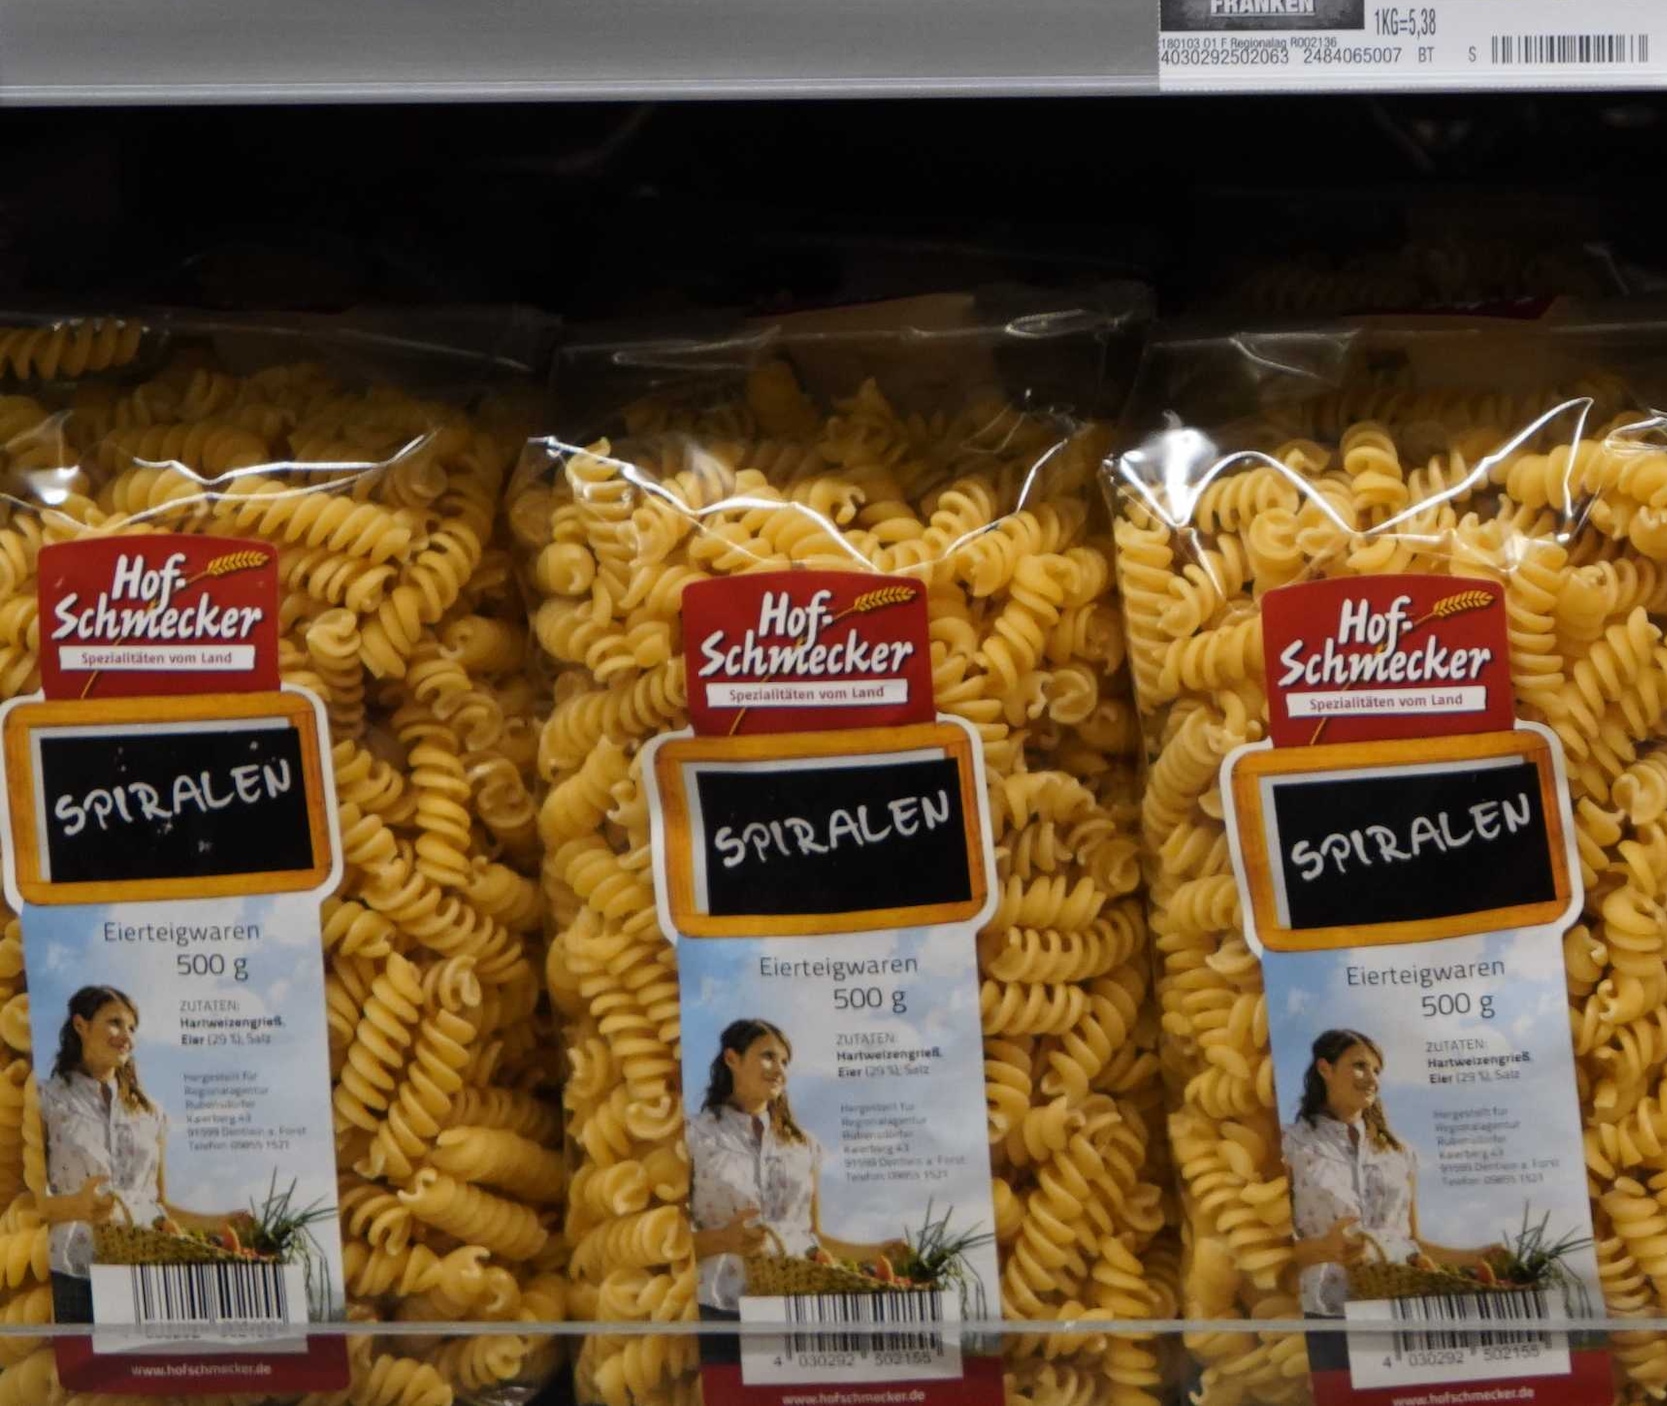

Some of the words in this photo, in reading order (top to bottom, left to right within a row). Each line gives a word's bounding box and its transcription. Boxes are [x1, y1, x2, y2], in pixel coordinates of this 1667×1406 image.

[1220, 38, 1227, 48] F
[1374, 8, 1437, 39] 1KG=5,38
[1161, 48, 1290, 66] 4030292502063
[1303, 48, 1402, 64] 2484065007
[1419, 47, 1433, 62] BT
[1469, 46, 1476, 62] S
[112, 552, 186, 612] Hof-
[52, 592, 262, 640] Schmecker
[759, 589, 832, 648] Hof-
[1339, 595, 1413, 656] Hof-
[699, 629, 913, 678] Schmecker
[1278, 635, 1491, 688] Schmecker
[54, 758, 292, 836] SPIRALEN
[715, 789, 950, 869] SPIRALEN
[1290, 793, 1532, 881] SPIRALEN
[104, 921, 260, 947] Eierteigwaren
[760, 957, 918, 981] Eierteigwaren
[1347, 959, 1506, 988] Eierteigwaren
[834, 988, 883, 1009] 500
[892, 990, 907, 1013] g
